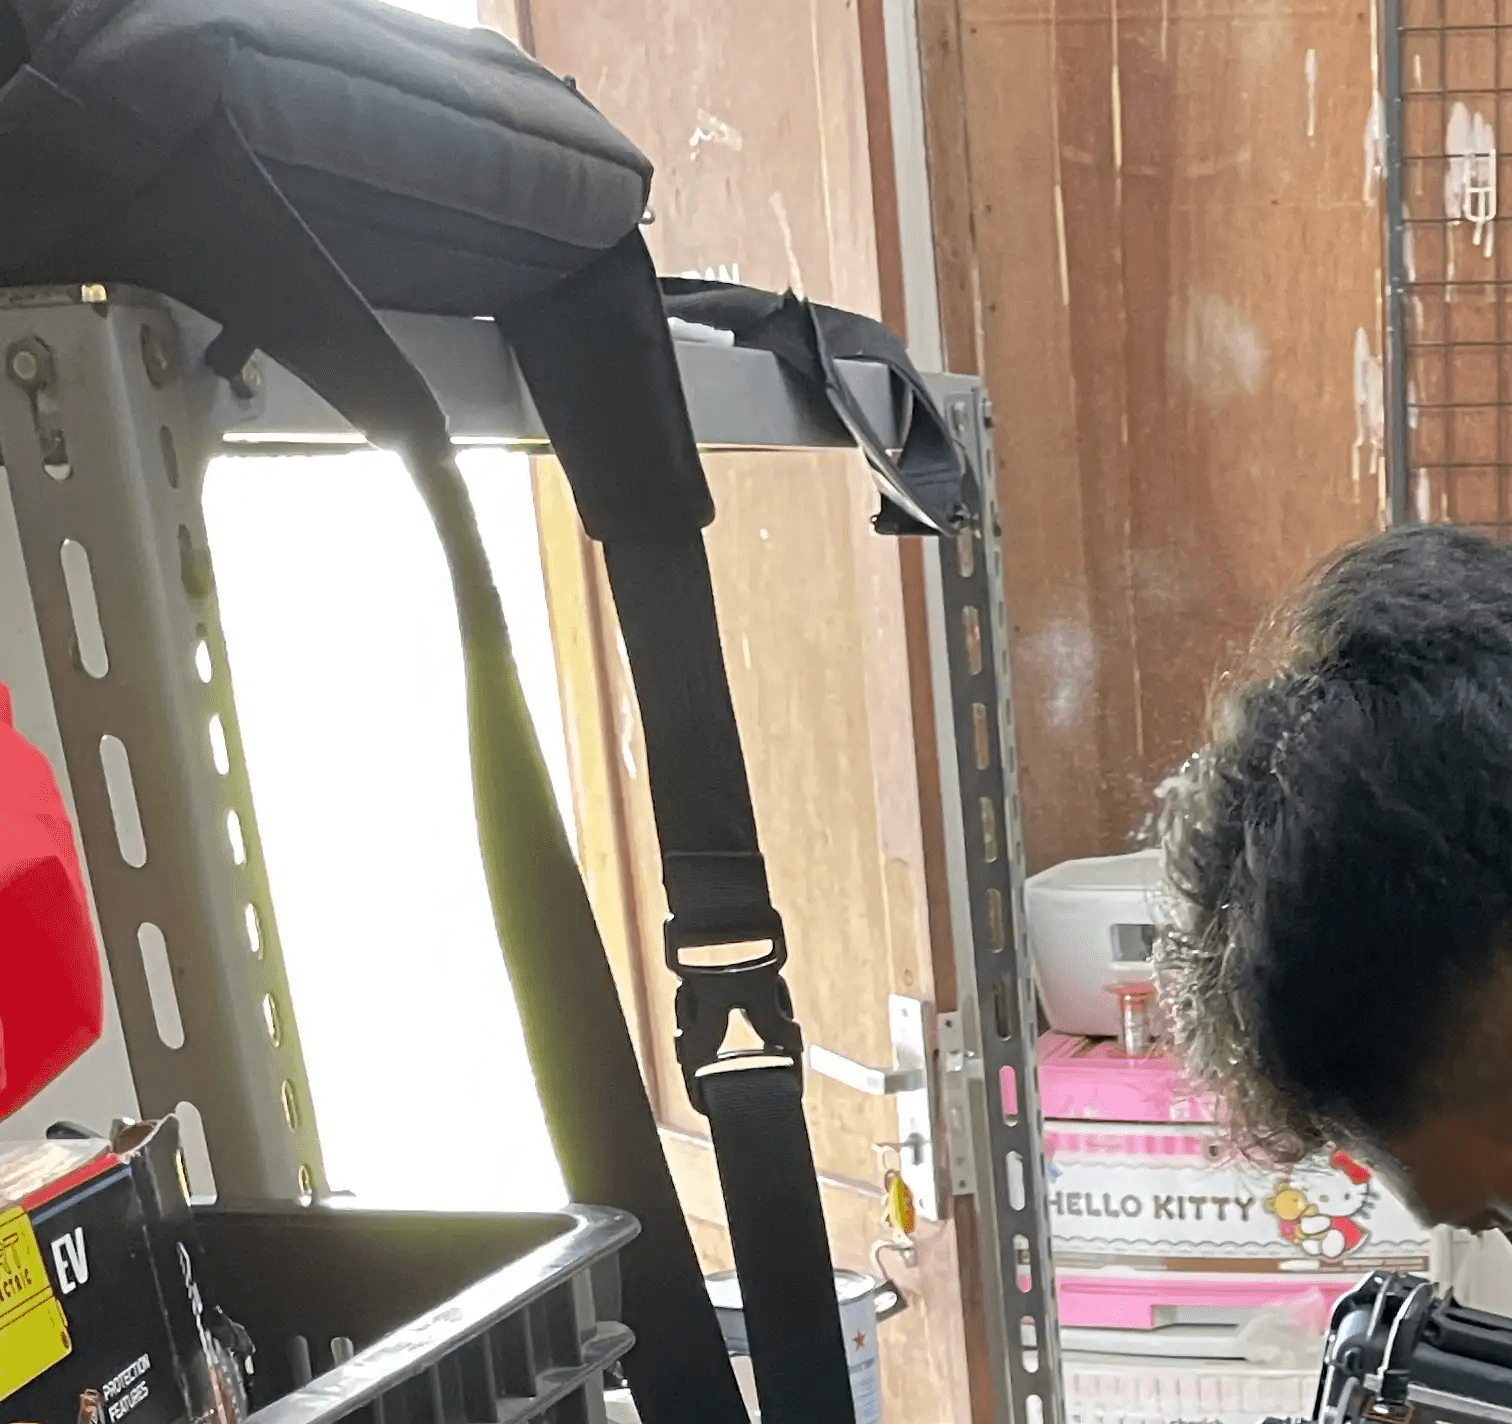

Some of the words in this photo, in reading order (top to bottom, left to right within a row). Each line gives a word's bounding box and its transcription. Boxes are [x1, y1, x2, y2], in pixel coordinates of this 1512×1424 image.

[1050, 1191, 1142, 1218] HELLO
[1153, 1194, 1255, 1221] KITTY
[51, 1226, 89, 1294] EV
[102, 1353, 151, 1401] PROTECTION
[108, 1380, 149, 1423] FEATURES
